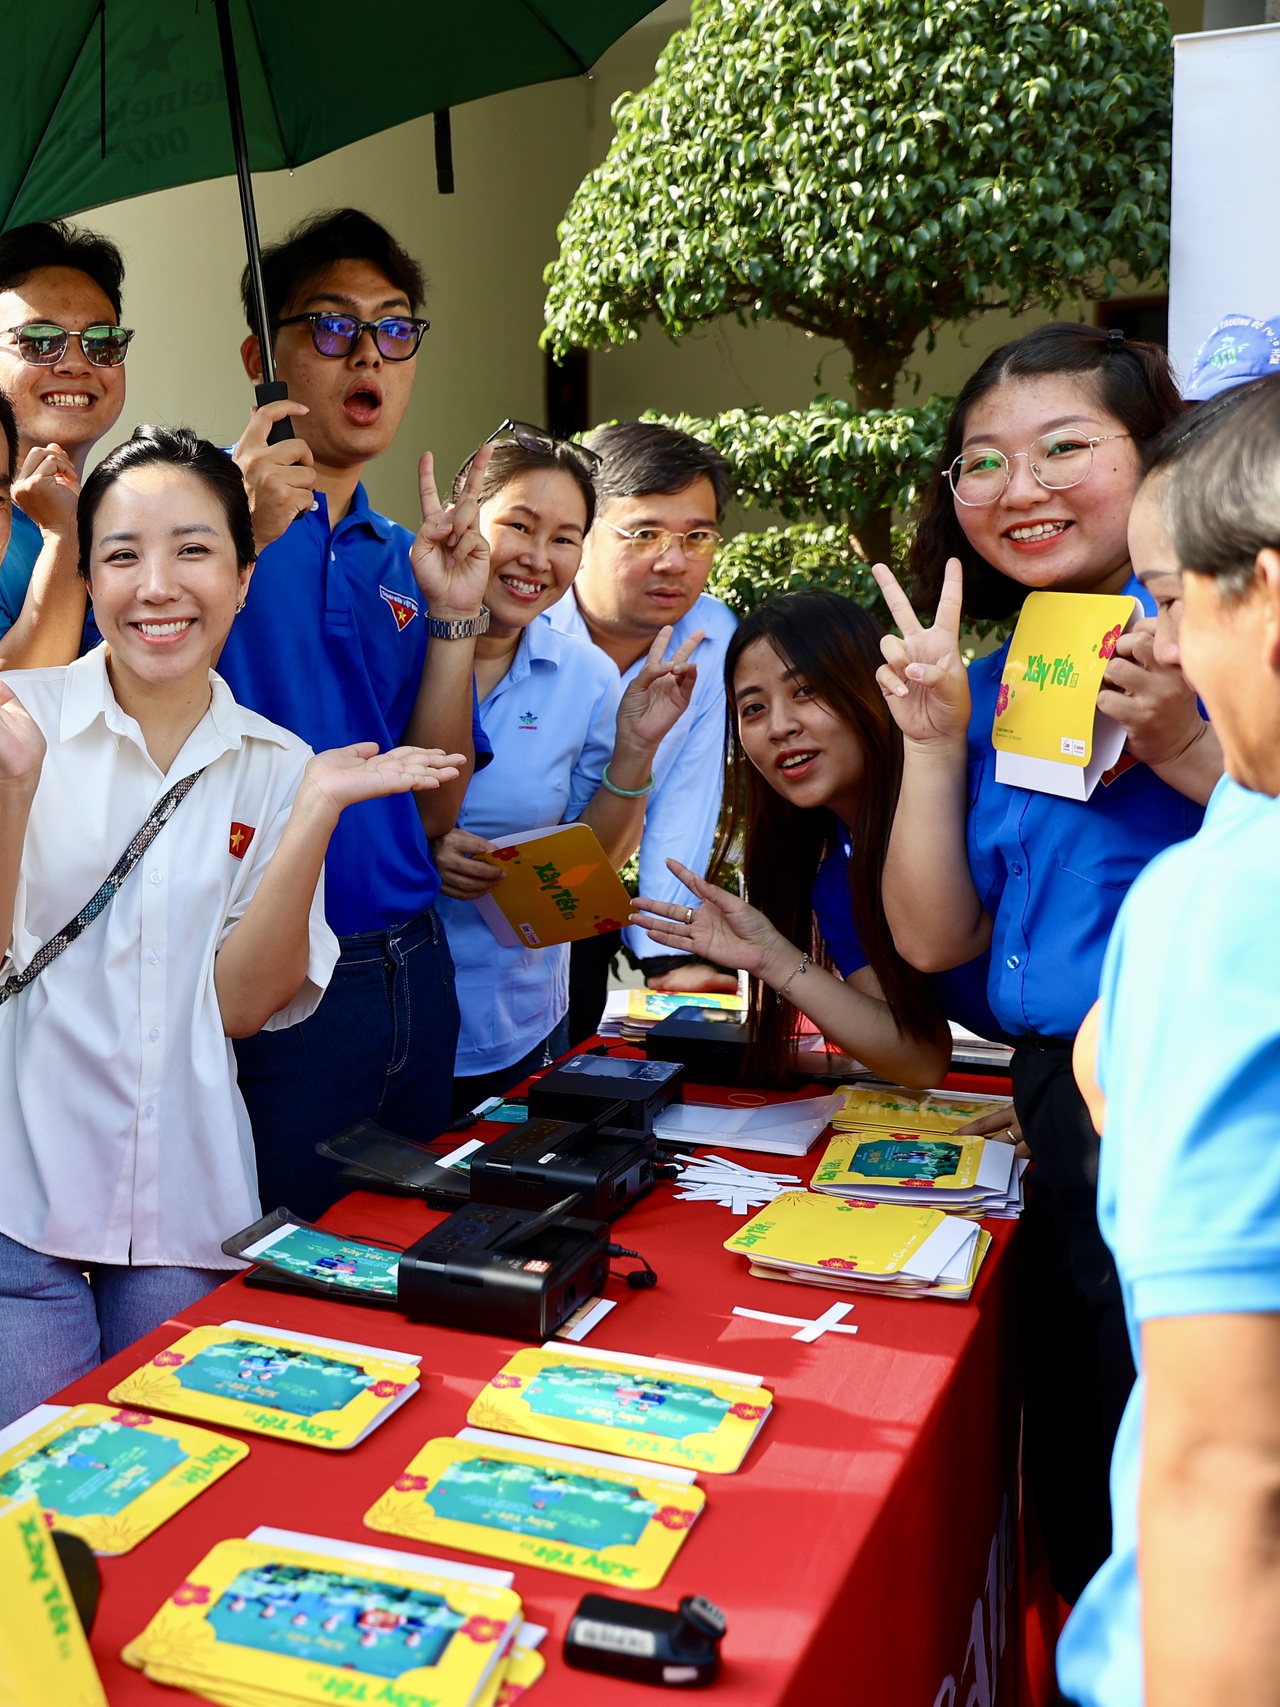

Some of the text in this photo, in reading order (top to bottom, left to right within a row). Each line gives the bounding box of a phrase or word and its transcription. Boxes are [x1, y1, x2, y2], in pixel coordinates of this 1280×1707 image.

[1022, 654, 1052, 691] Xây
[1050, 654, 1074, 687] Tết
[532, 861, 563, 892] Xây
[551, 889, 580, 912] Tết
